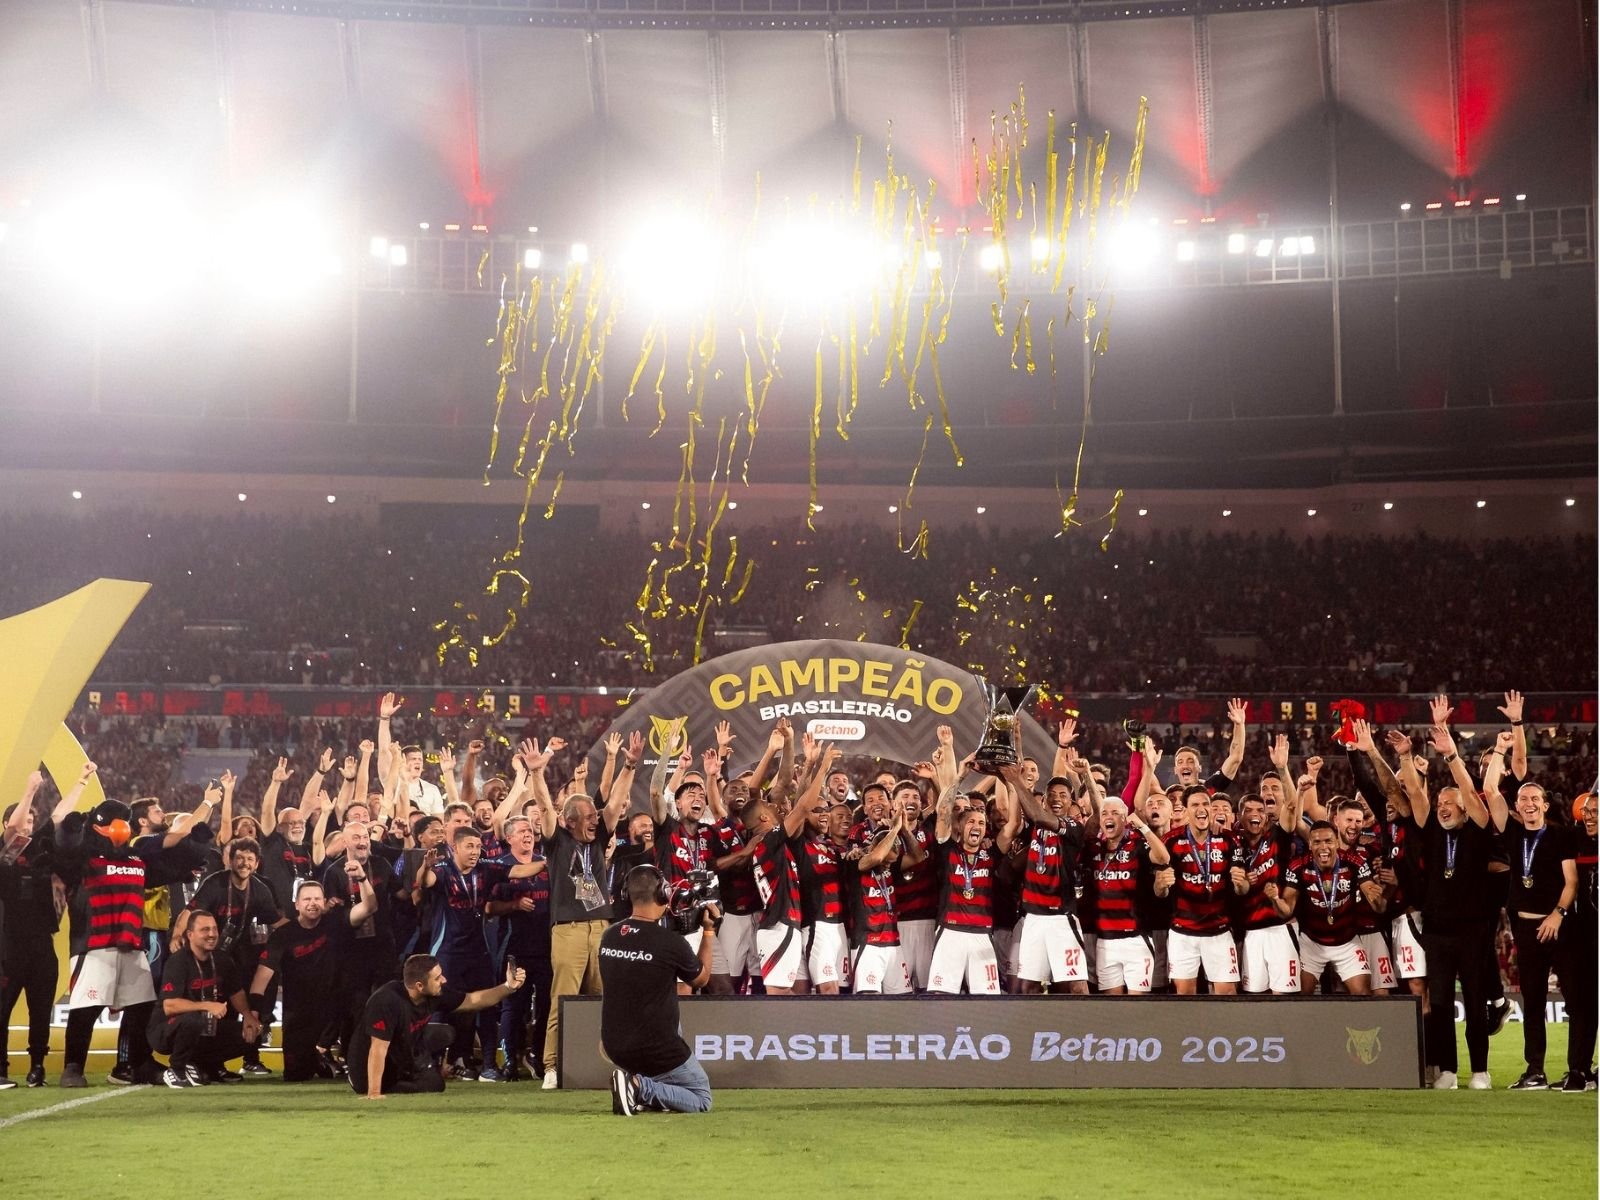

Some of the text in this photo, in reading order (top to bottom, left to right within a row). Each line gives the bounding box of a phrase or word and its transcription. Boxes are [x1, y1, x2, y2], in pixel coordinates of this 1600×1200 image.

[709, 658, 963, 715] CAMPEÃO
[508, 694, 521, 714] 9
[760, 700, 912, 723] BRASILEIRÃO
[1305, 701, 1317, 720] 9
[814, 723, 859, 736] Betano
[107, 865, 144, 876] Betano
[601, 947, 653, 961] PRODUÇÃO
[1064, 949, 1080, 966] 27
[1229, 947, 1236, 964] 9
[1401, 946, 1414, 964] 13
[984, 964, 997, 981] 10
[1143, 958, 1151, 975] 7
[1288, 960, 1296, 977] 6
[1378, 957, 1392, 974] 21
[695, 1026, 1287, 1063] BRASILEIRÃO Betano 2025
